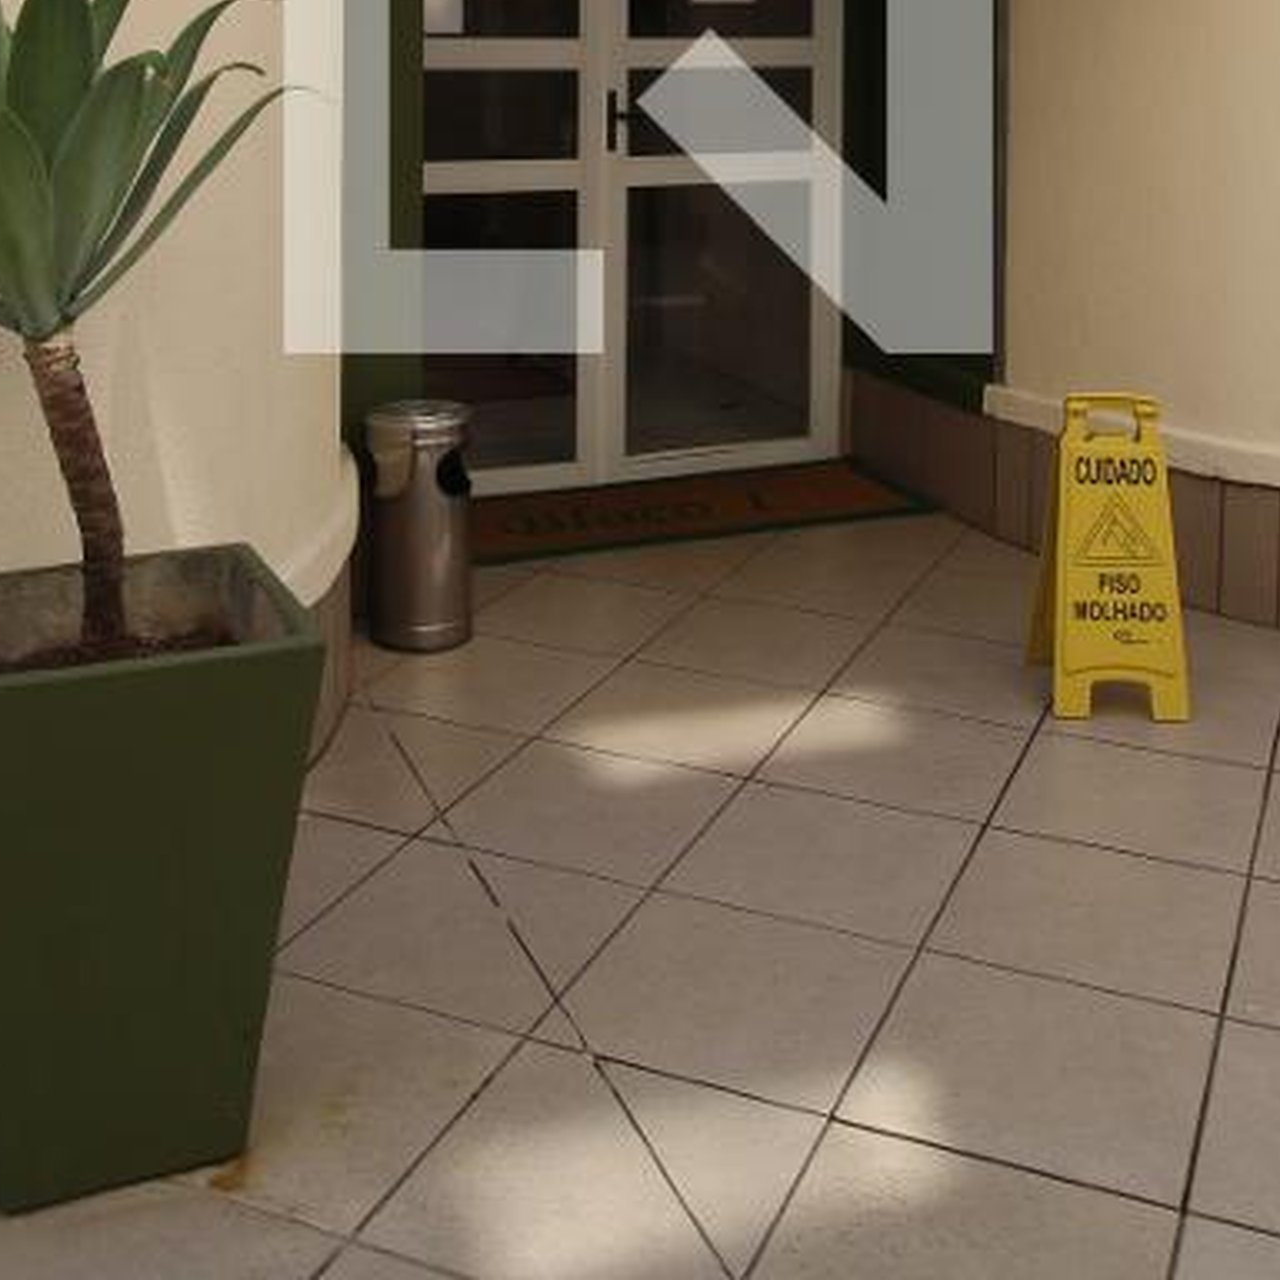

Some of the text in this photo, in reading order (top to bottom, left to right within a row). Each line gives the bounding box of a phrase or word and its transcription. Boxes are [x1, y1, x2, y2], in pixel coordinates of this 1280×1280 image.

[1075, 456, 1158, 485] CUIDADO
[1099, 573, 1141, 595] PISO
[1073, 602, 1168, 622] MOLHADO
